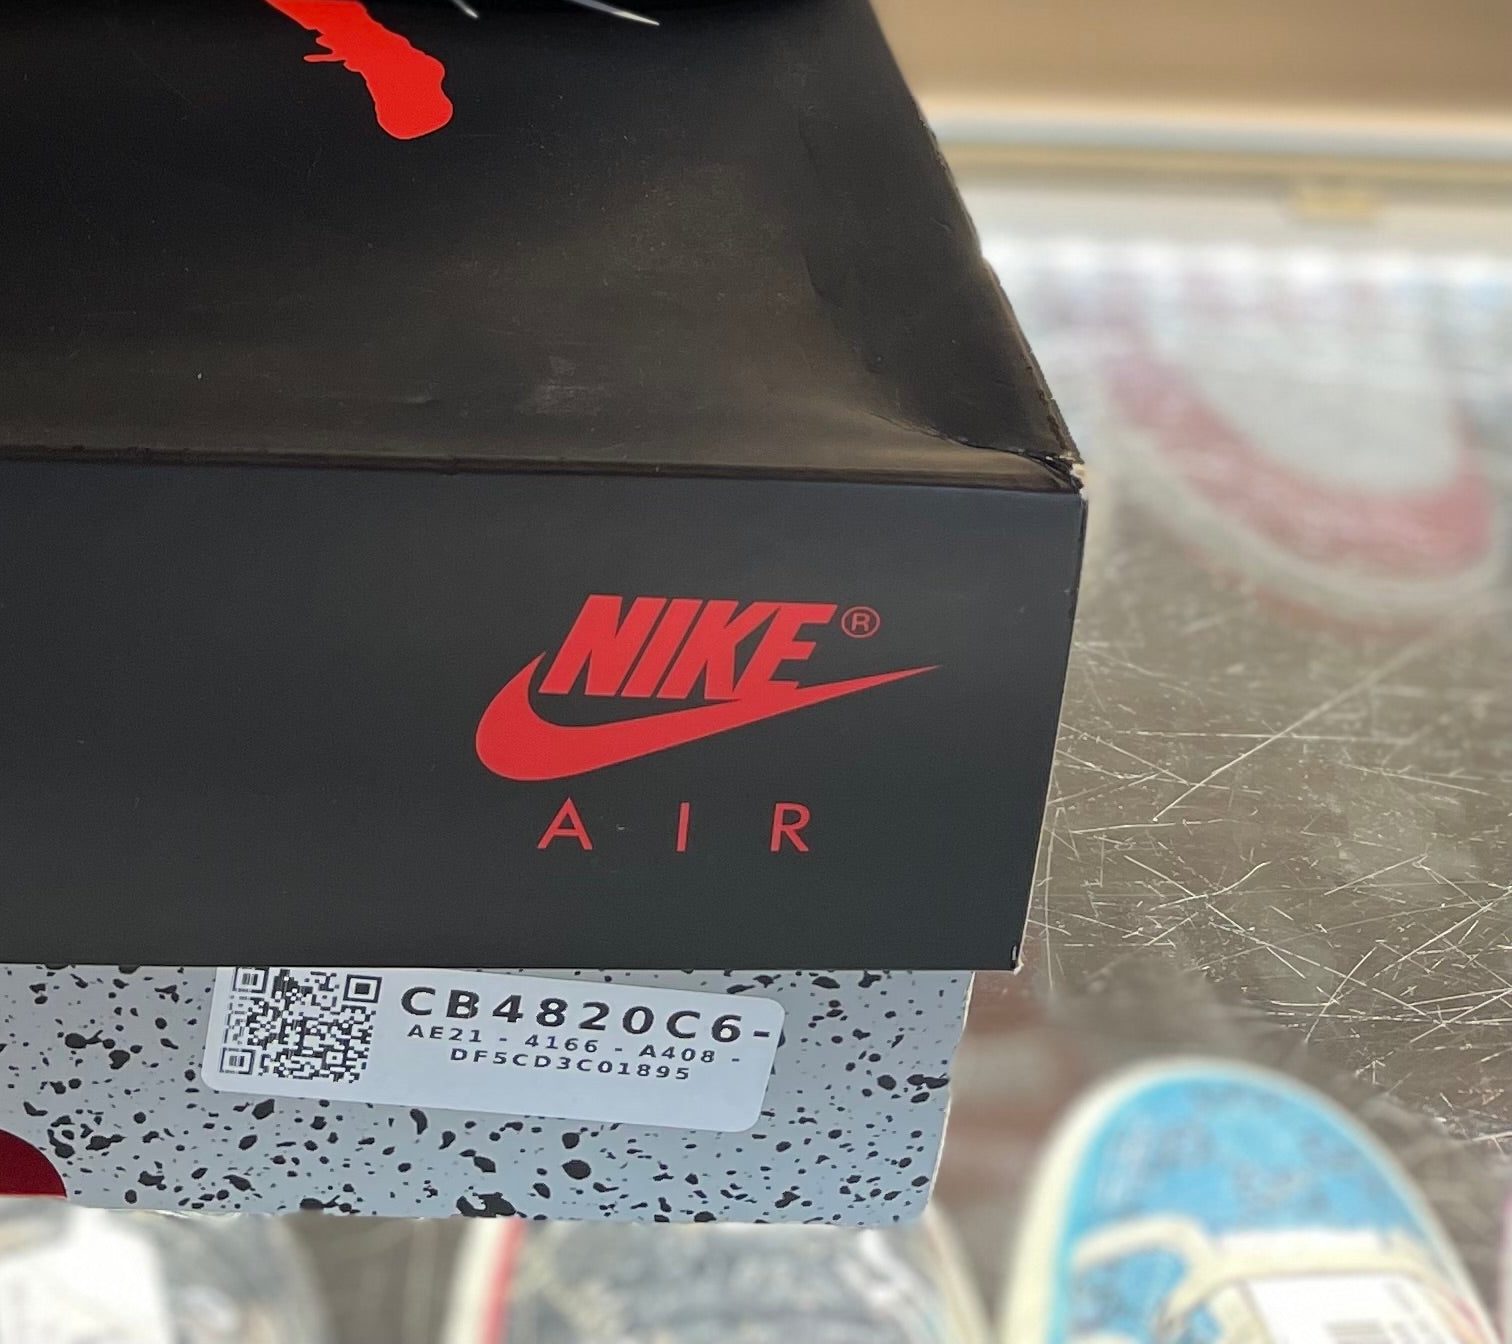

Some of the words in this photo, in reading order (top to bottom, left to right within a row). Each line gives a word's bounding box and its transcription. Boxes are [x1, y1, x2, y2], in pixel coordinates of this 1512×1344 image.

[538, 593, 838, 702] NIKE
[537, 797, 811, 852] AIR
[407, 1023, 483, 1044] AE21
[524, 1034, 599, 1054] 4166
[638, 1044, 716, 1064] A408
[449, 1048, 690, 1081] DF5CD3C01895
